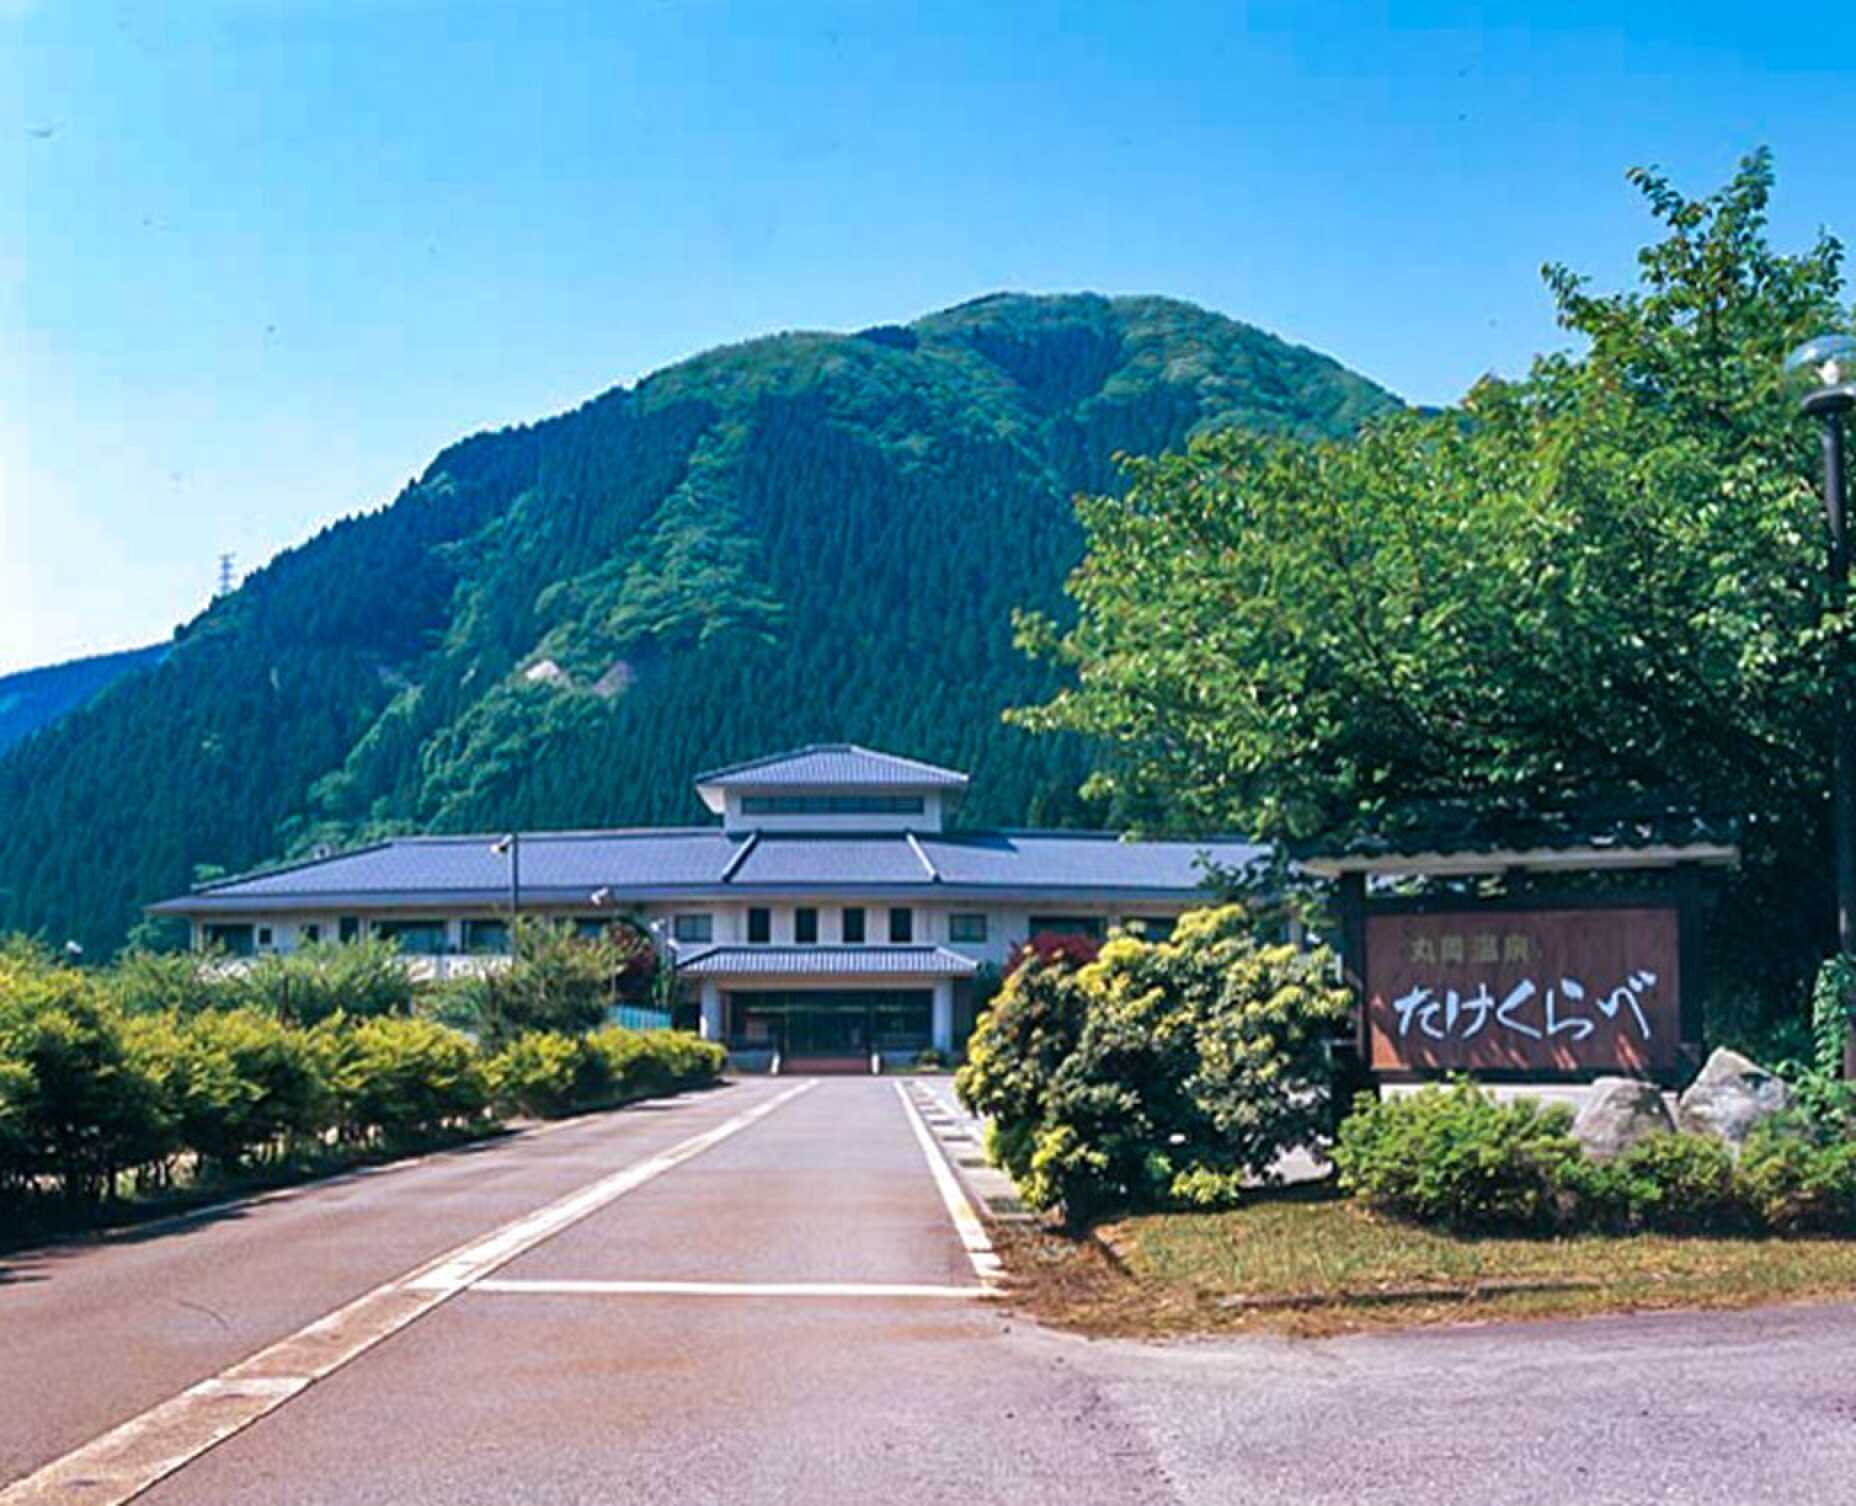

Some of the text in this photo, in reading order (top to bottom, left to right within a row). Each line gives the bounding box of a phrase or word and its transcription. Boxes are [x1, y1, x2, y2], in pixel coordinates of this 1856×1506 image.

[1393, 970, 1656, 1039] たけくらべ
